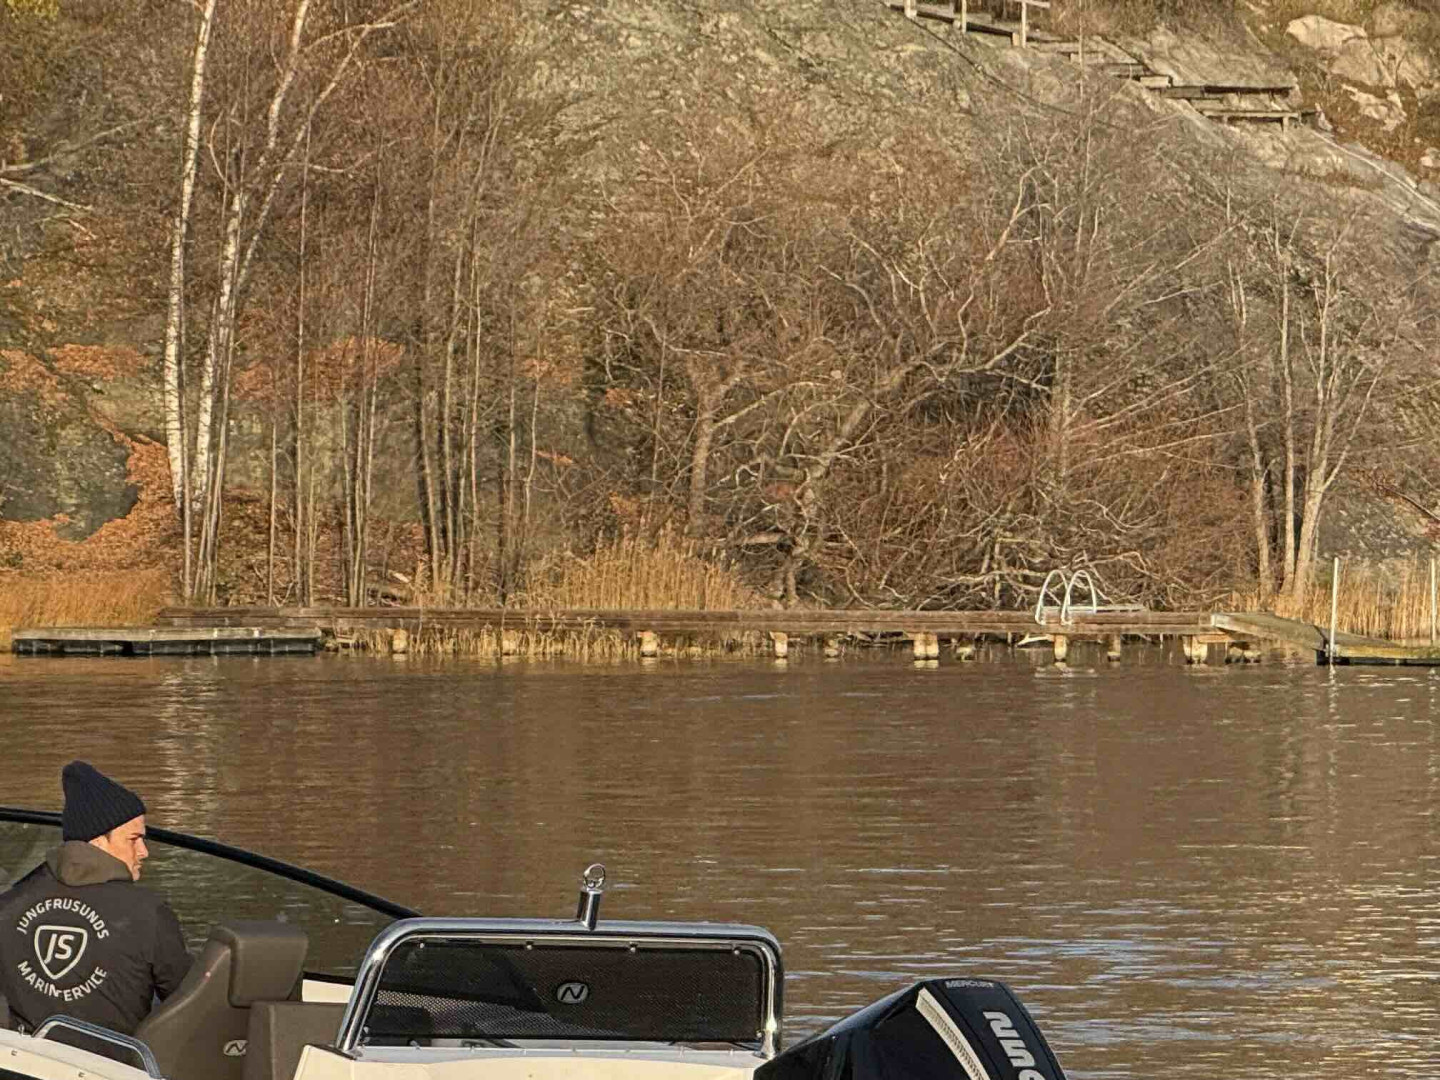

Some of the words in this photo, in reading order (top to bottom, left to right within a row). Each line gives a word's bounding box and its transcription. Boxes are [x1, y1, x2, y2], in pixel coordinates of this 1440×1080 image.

[17, 898, 109, 939] JUNGFRUSUNDS
[44, 933, 75, 964] JS
[18, 960, 108, 1002] MARINERVICE
